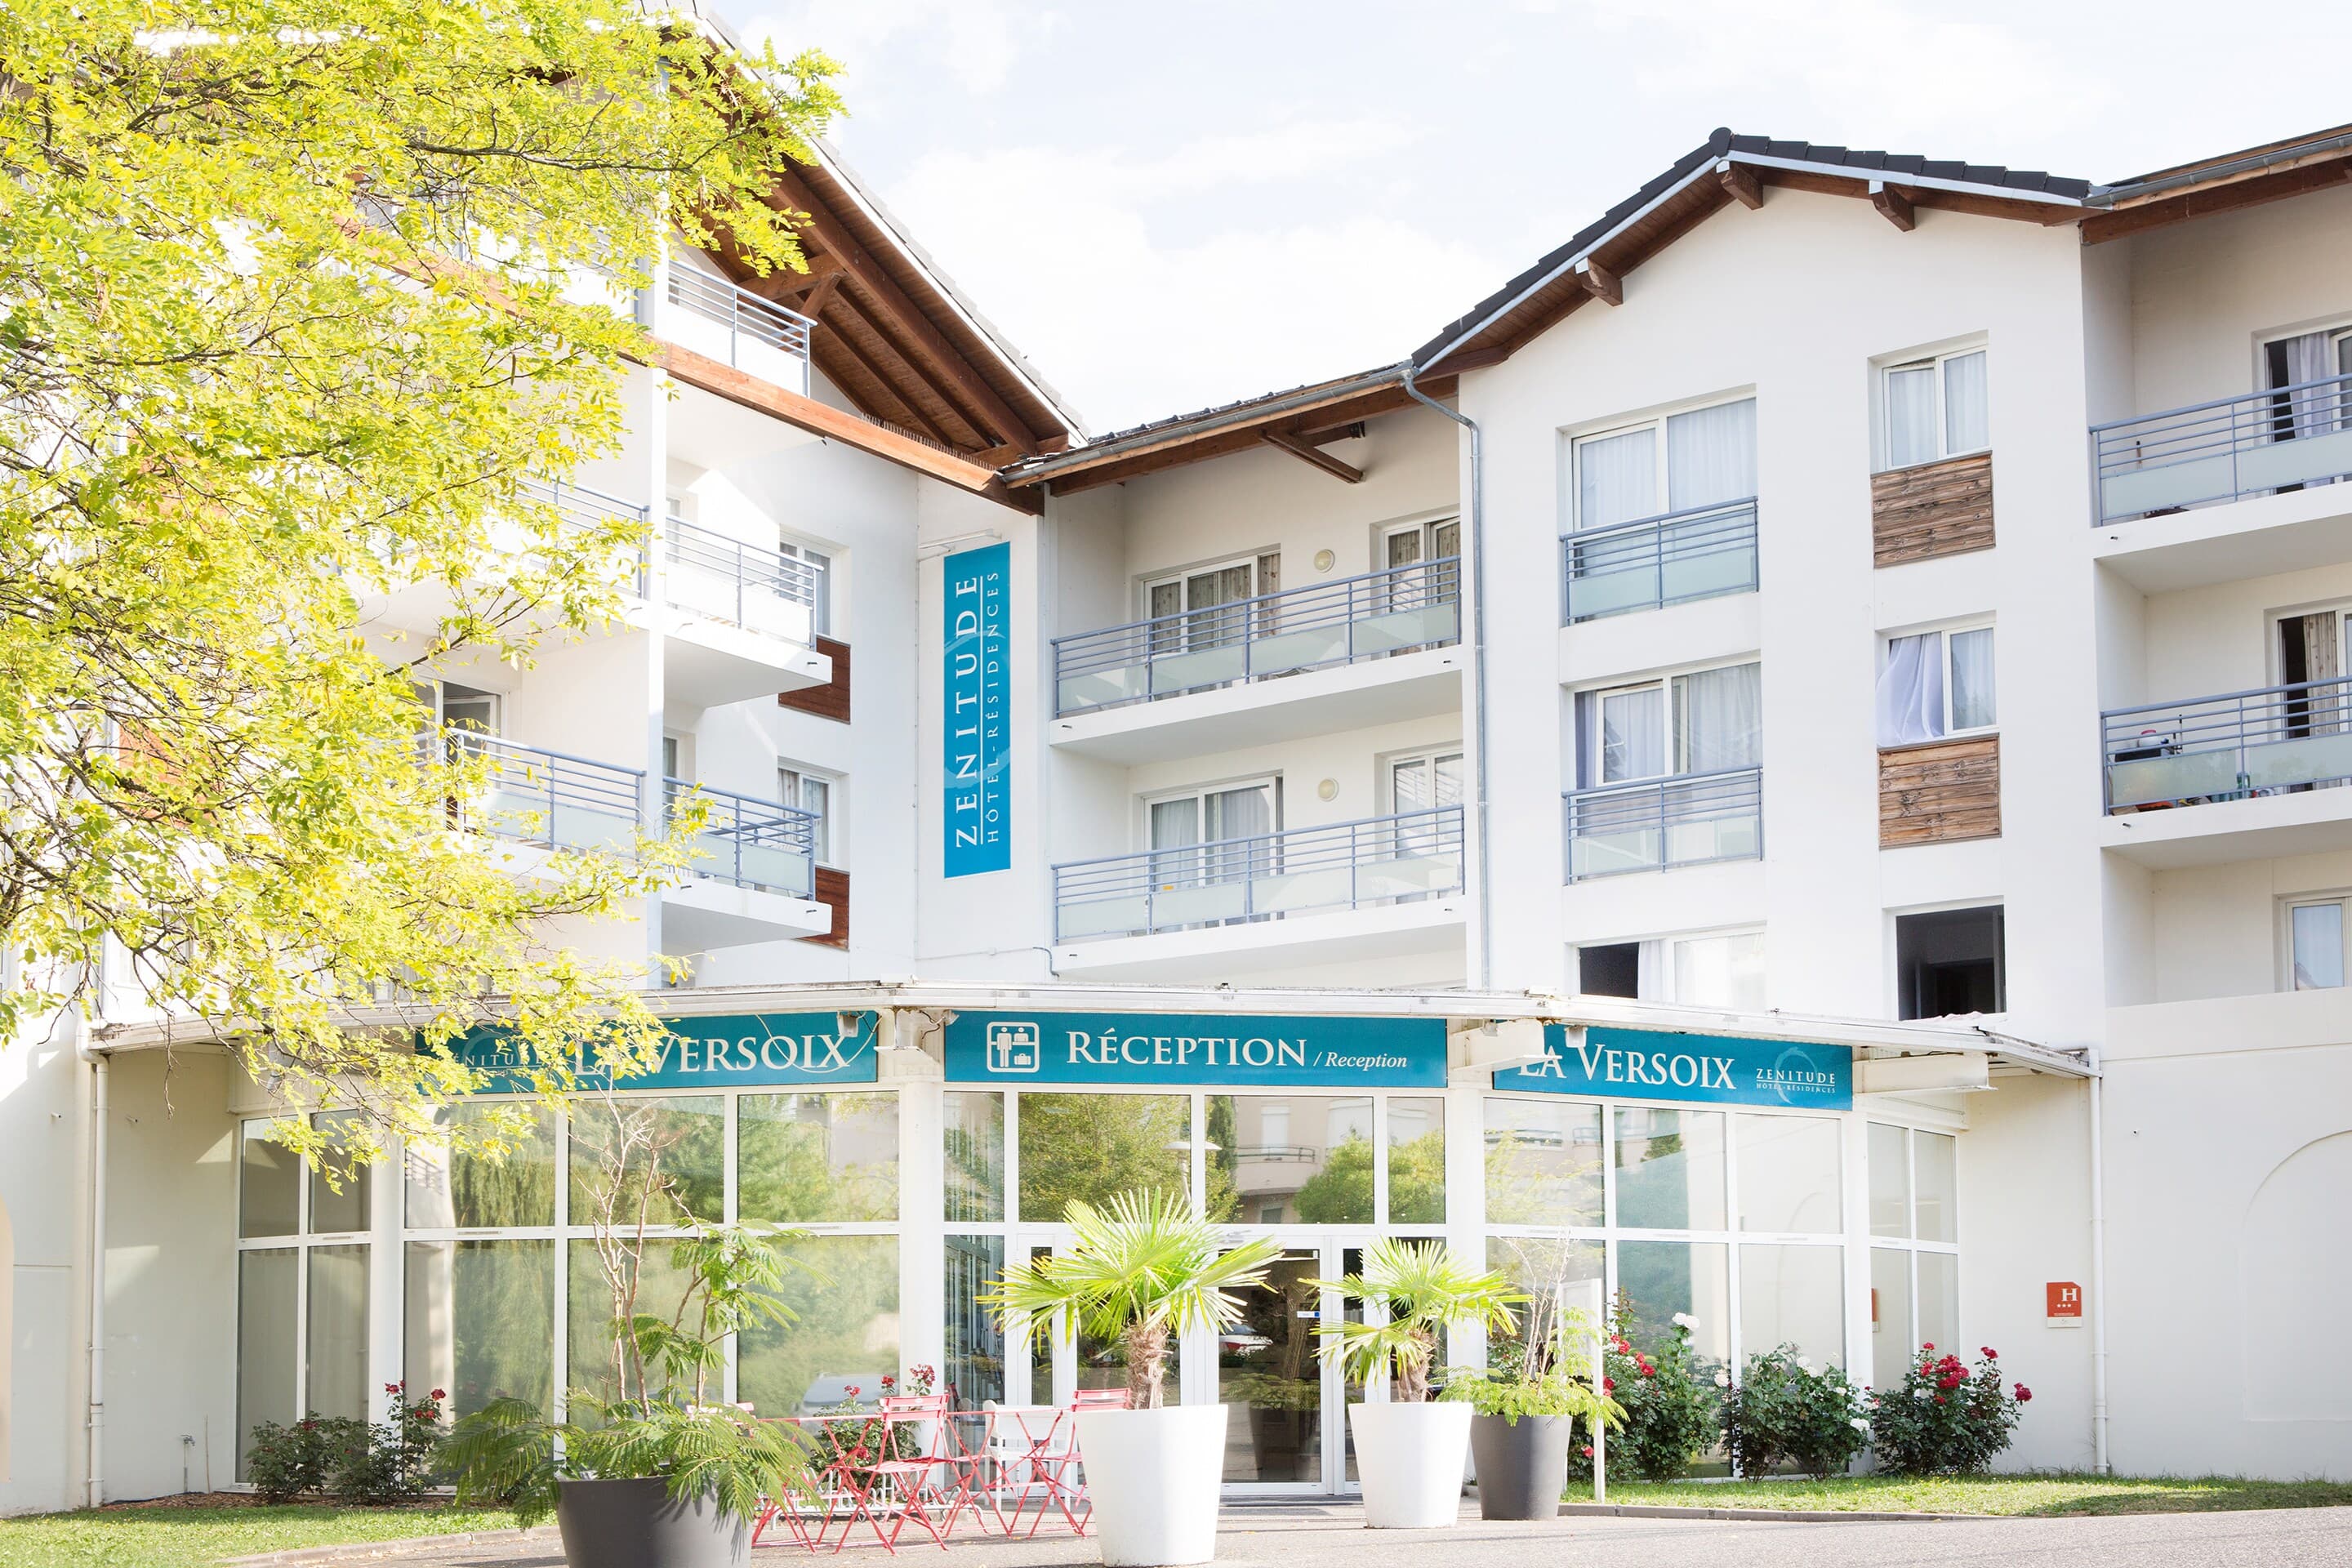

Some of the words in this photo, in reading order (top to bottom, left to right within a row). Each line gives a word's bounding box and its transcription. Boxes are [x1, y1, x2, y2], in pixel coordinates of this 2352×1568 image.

[956, 577, 978, 848] ZENITUDE
[441, 1051, 544, 1066] ENITU
[642, 1032, 850, 1074] VERSOIX
[1065, 1027, 1307, 1067] RÉCEPTION
[1324, 1051, 1407, 1071] Reception
[1575, 1043, 1736, 1090] VERSOIX
[1756, 1068, 1836, 1085] ZENITUDE
[2061, 1288, 2078, 1302] H
